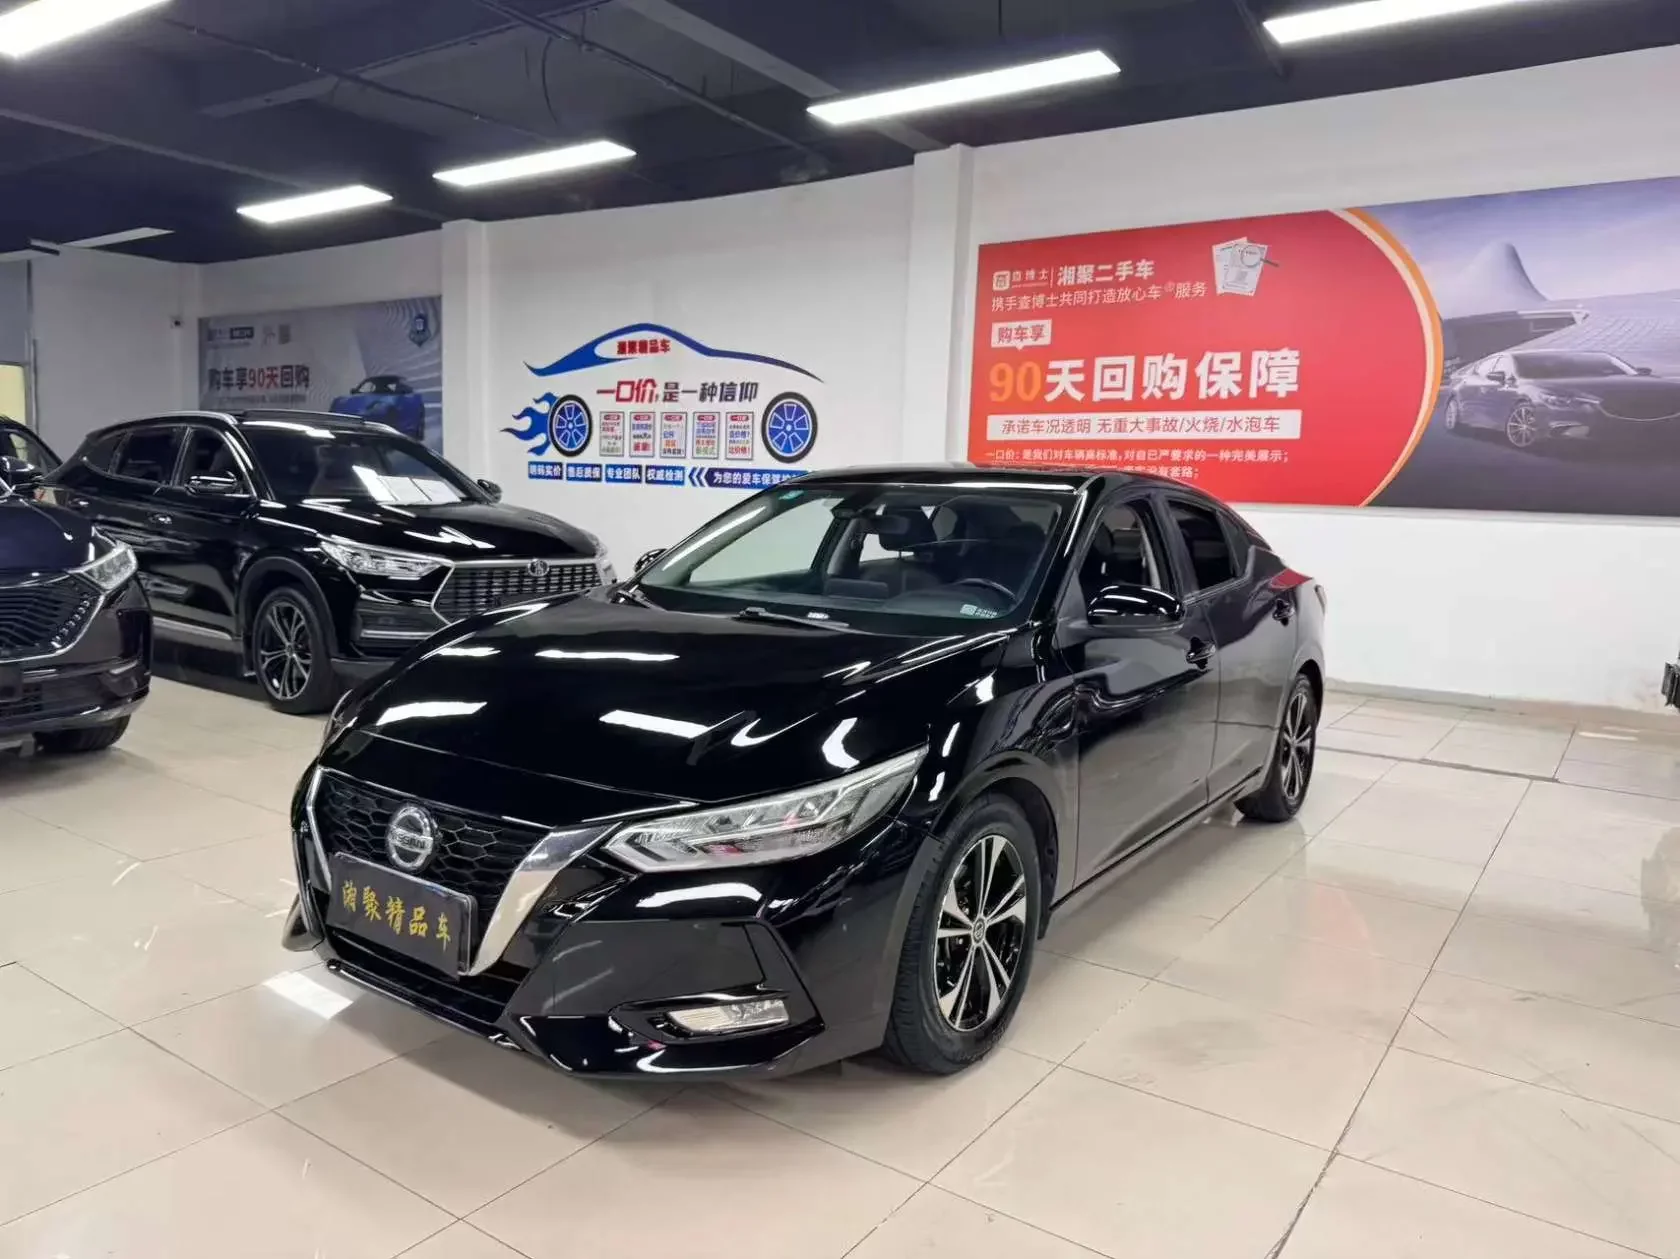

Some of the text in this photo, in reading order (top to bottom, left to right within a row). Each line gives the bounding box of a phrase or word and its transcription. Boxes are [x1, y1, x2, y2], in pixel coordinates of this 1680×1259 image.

[1057, 259, 1155, 287] 湘聚二手车
[998, 324, 1046, 344] 购车享
[208, 365, 310, 391] 购车享90天回购
[989, 347, 1300, 401] 90天回购保障
[1001, 416, 1281, 434] 承诺车况透明 无重大事故/火烧/水泡车
[606, 467, 641, 480] 专业团队
[646, 468, 685, 482] 权威检测
